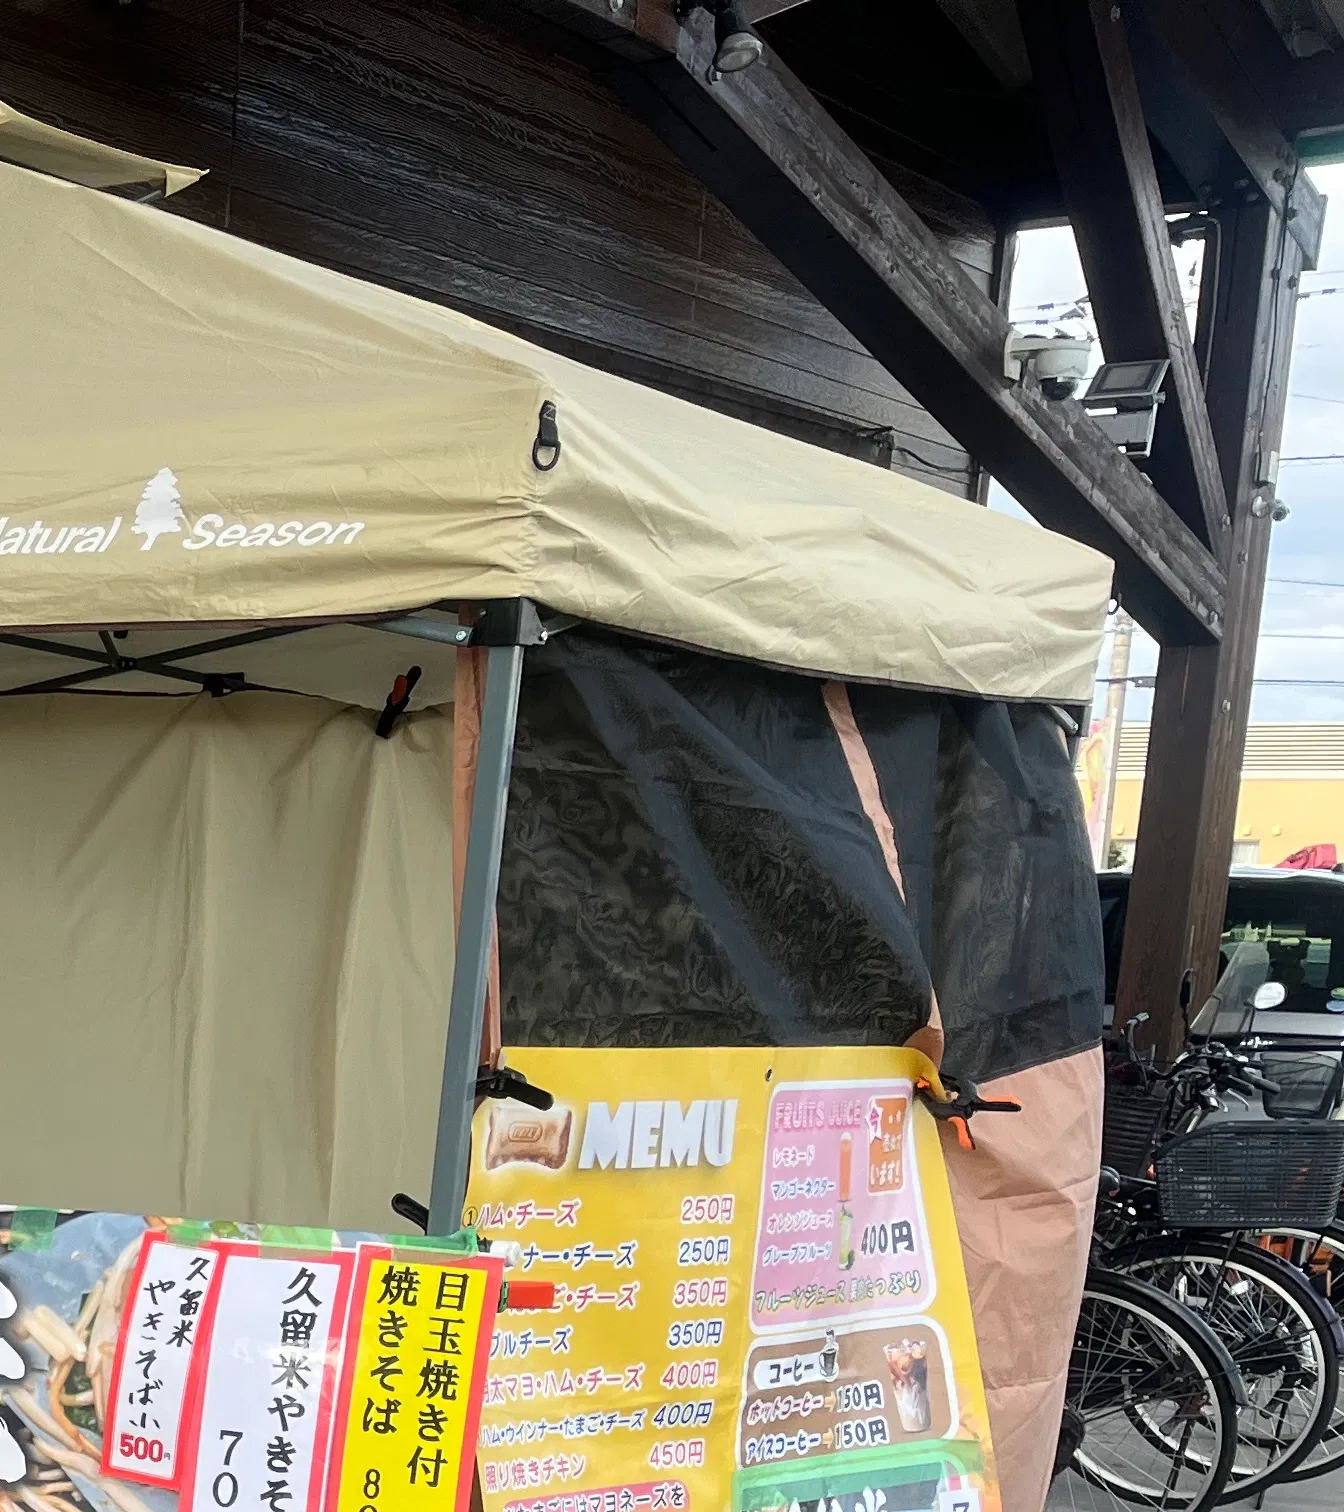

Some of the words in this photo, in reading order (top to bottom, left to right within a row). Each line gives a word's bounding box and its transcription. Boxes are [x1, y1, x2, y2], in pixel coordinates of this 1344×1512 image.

[182, 513, 365, 551] Season
[775, 1101, 825, 1129] FRUITS
[828, 1100, 861, 1127] JUICE
[578, 1099, 738, 1170] MEMU
[773, 1146, 815, 1167] レモネード
[771, 1180, 835, 1200] マンゴーネクター
[477, 1200, 580, 1227] ハム・チーズ
[681, 1196, 734, 1224] 250円
[767, 1209, 833, 1234] オレンジジュース
[518, 1241, 637, 1270] ナー・チーズ
[679, 1238, 729, 1265] 250円
[763, 1242, 833, 1267] グレープフルーツ
[166, 1257, 210, 1347] 久留米
[512, 1283, 638, 1313] ご・チーズ
[674, 1279, 728, 1308] 350円
[363, 1265, 420, 1434] 焼きそば
[668, 1320, 723, 1348] 350円
[129, 1279, 175, 1429] やきそば小
[406, 1271, 470, 1488] 目玉焼き付
[662, 1361, 717, 1388] 400円
[769, 1358, 814, 1383] コーヒー
[654, 1401, 713, 1427] 400円
[747, 1392, 824, 1425] ホットコーヒー
[837, 1380, 884, 1412] 150円
[120, 1432, 170, 1463] 500円
[746, 1429, 821, 1464] アイスコーヒー
[835, 1417, 889, 1448] 150円
[485, 1455, 586, 1492] 照り焼きチキン
[649, 1440, 704, 1467] 450円
